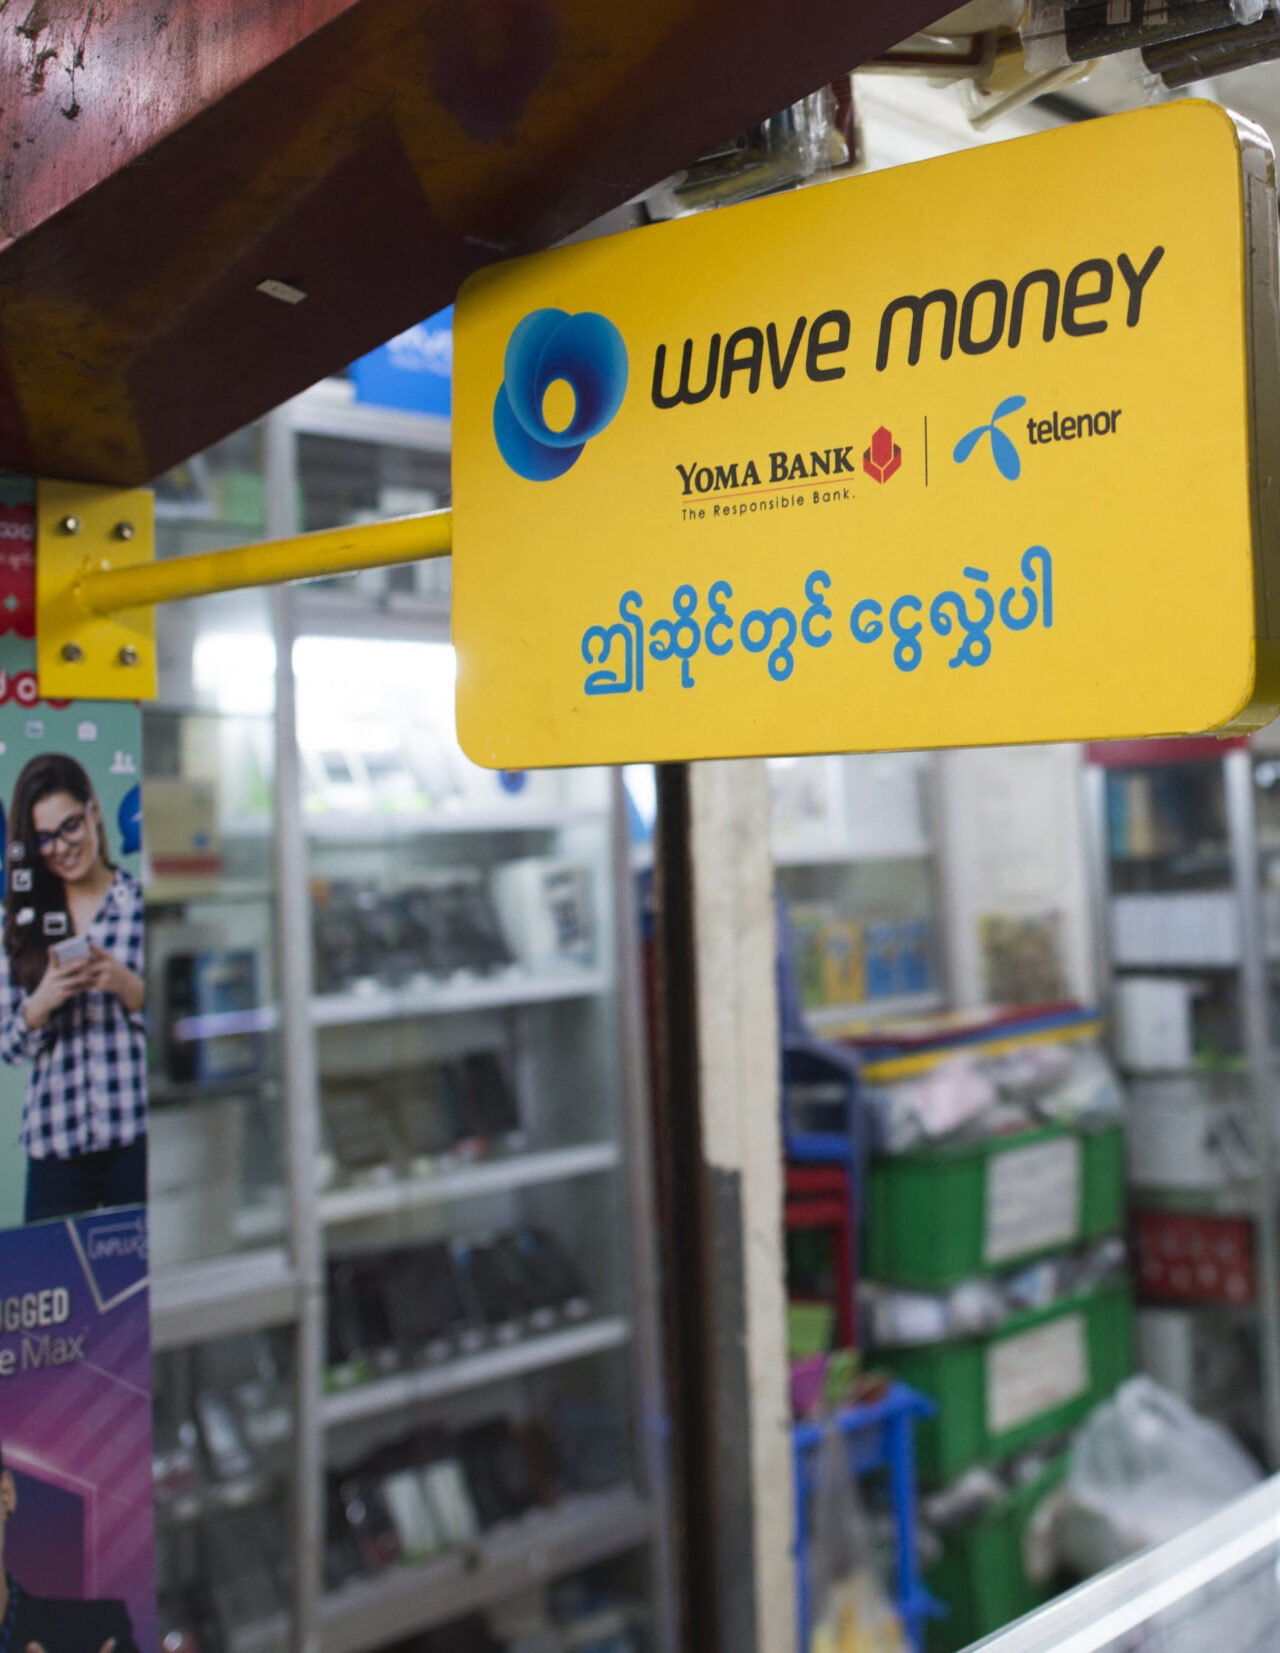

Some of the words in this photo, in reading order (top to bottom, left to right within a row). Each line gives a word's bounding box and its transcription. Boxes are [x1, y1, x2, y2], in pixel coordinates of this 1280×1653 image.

[1026, 408, 1122, 445] telenor
[676, 460, 762, 495] YOMA
[769, 446, 855, 483] BANK
[682, 509, 706, 522] The
[714, 495, 804, 518] Responsible
[813, 487, 857, 505] Bank.
[580, 569, 833, 696] ဤဆိုင်တွင်
[849, 545, 1053, 673] ငွေလွှဲပါ
[0, 1286, 70, 1332] GGED
[21, 1332, 86, 1371] Max
